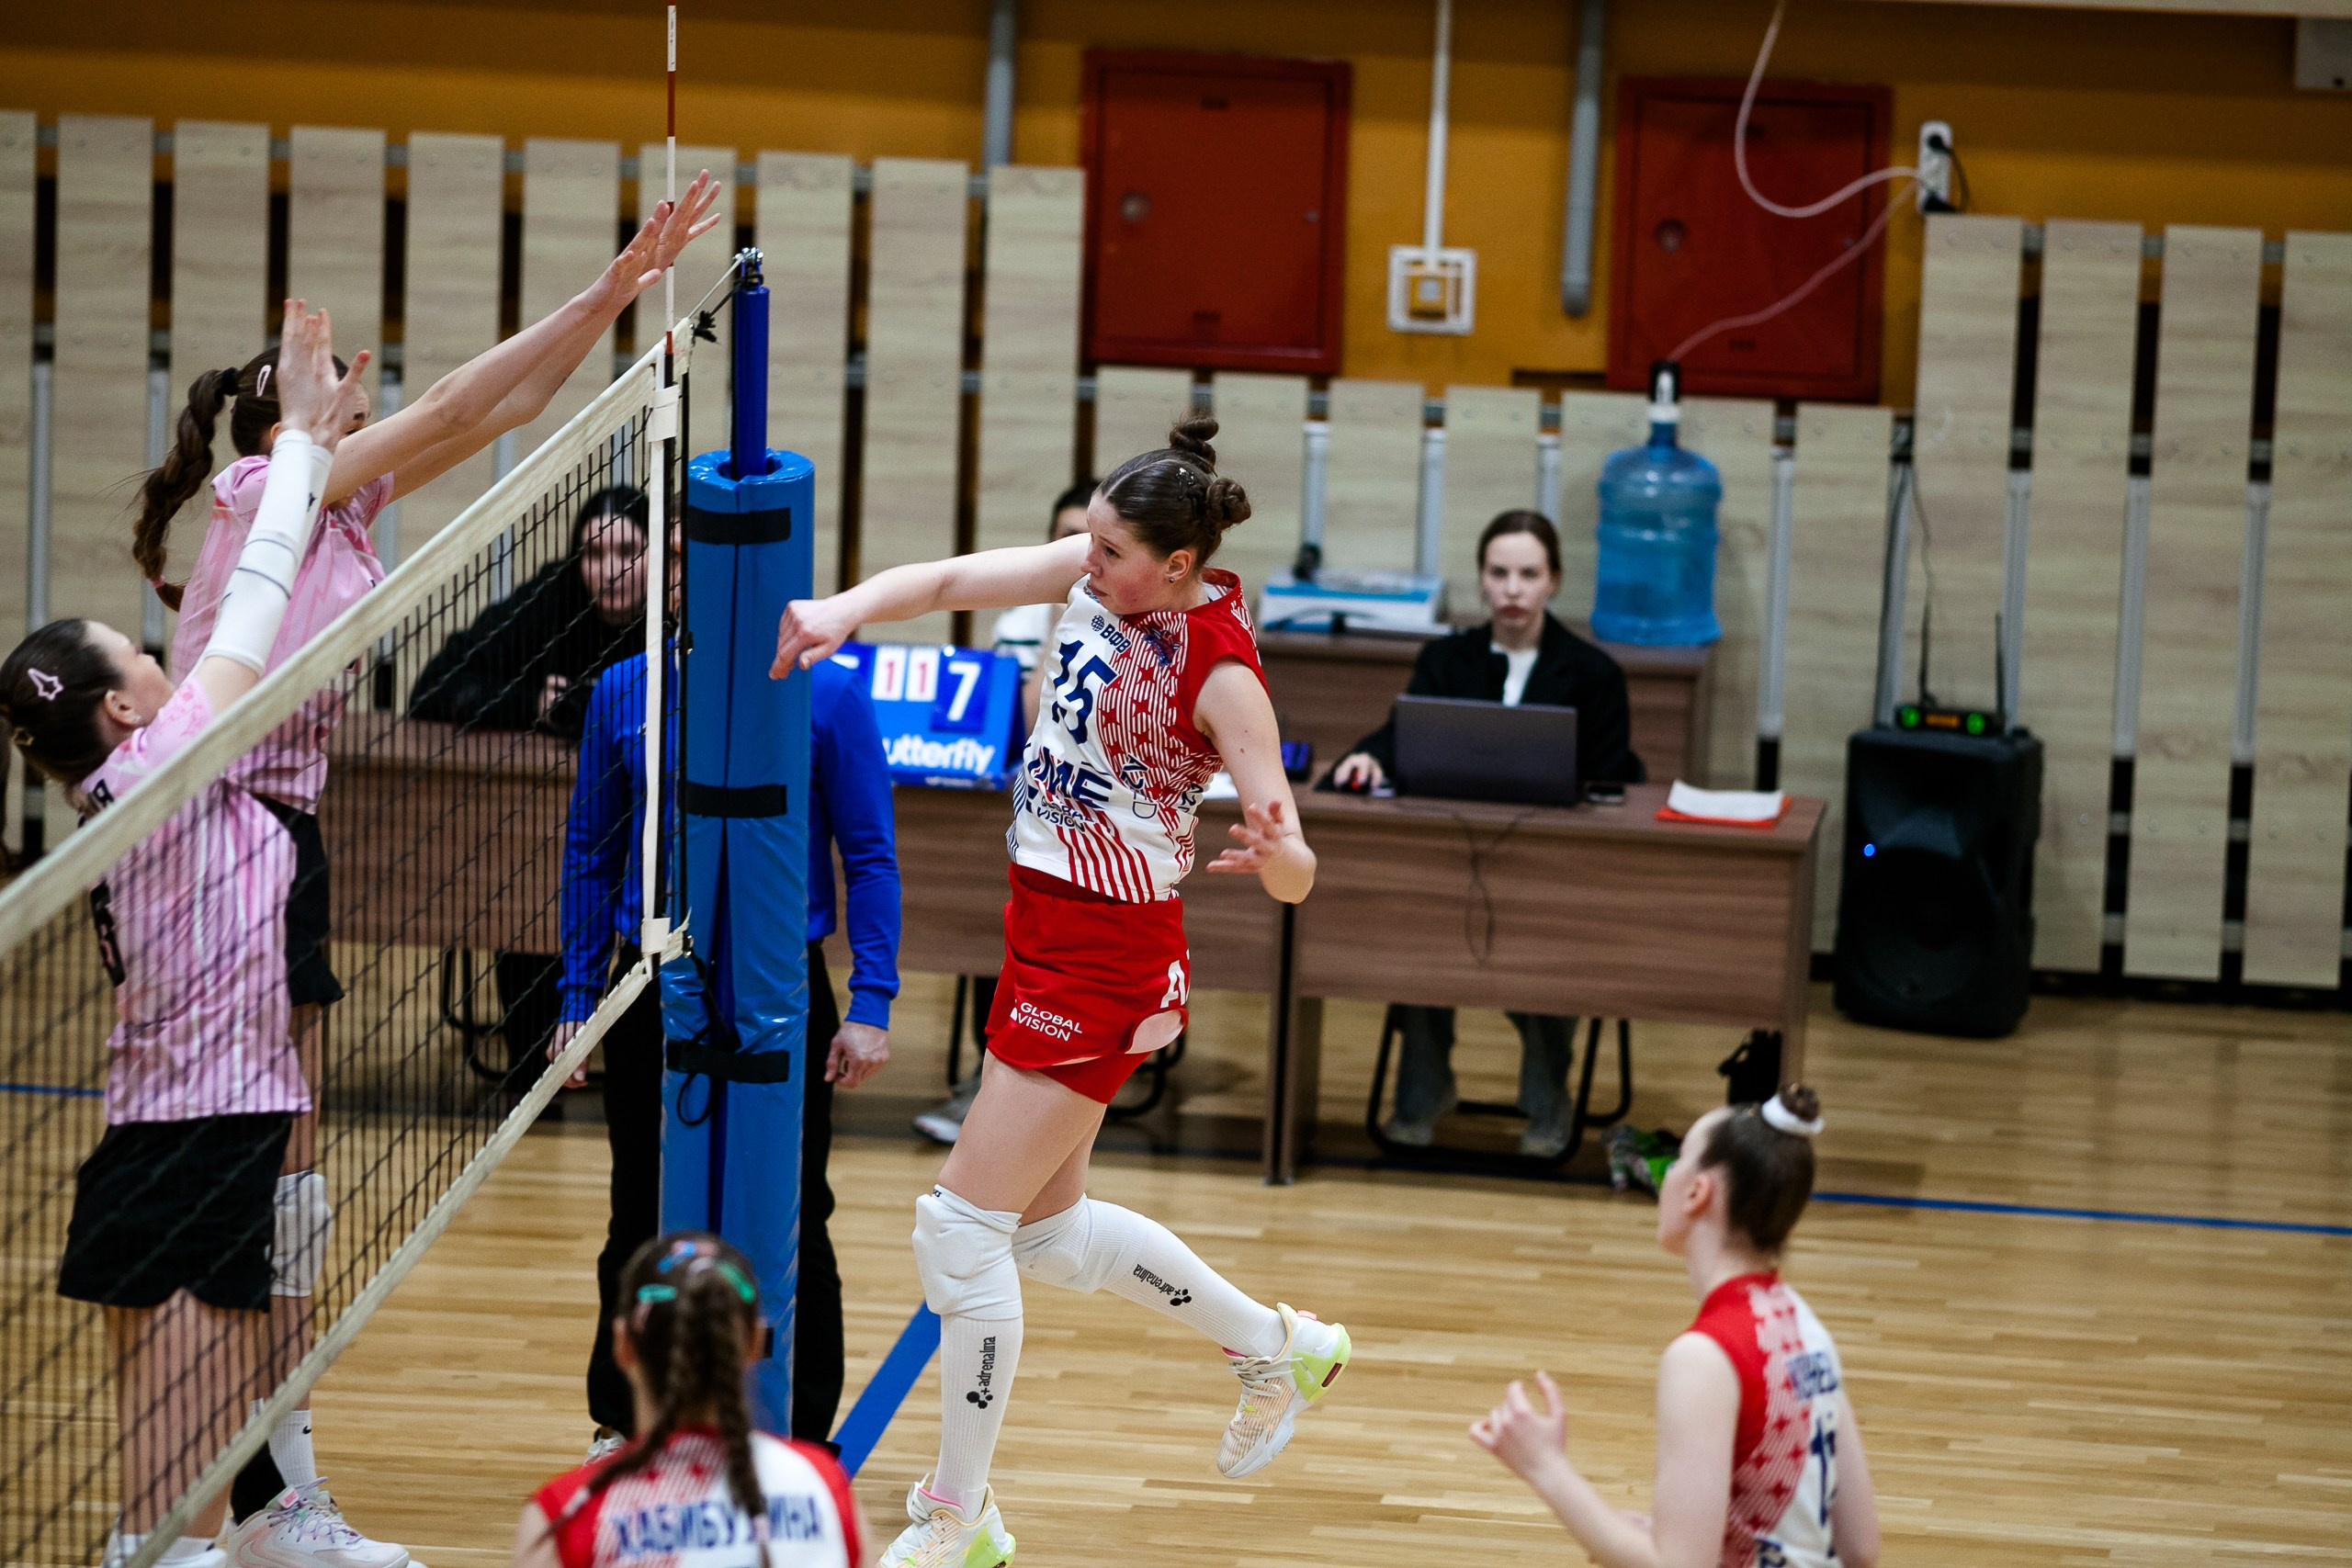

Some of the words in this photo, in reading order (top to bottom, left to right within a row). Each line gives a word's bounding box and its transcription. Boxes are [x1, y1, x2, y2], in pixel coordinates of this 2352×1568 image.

[946, 660, 981, 722] 7
[1052, 639, 1120, 745] 15
[881, 732, 996, 776] utterfly
[1036, 807, 1086, 832] VISION
[1016, 1012, 1071, 1042] VISION
[1020, 1001, 1083, 1034] GLOBAL
